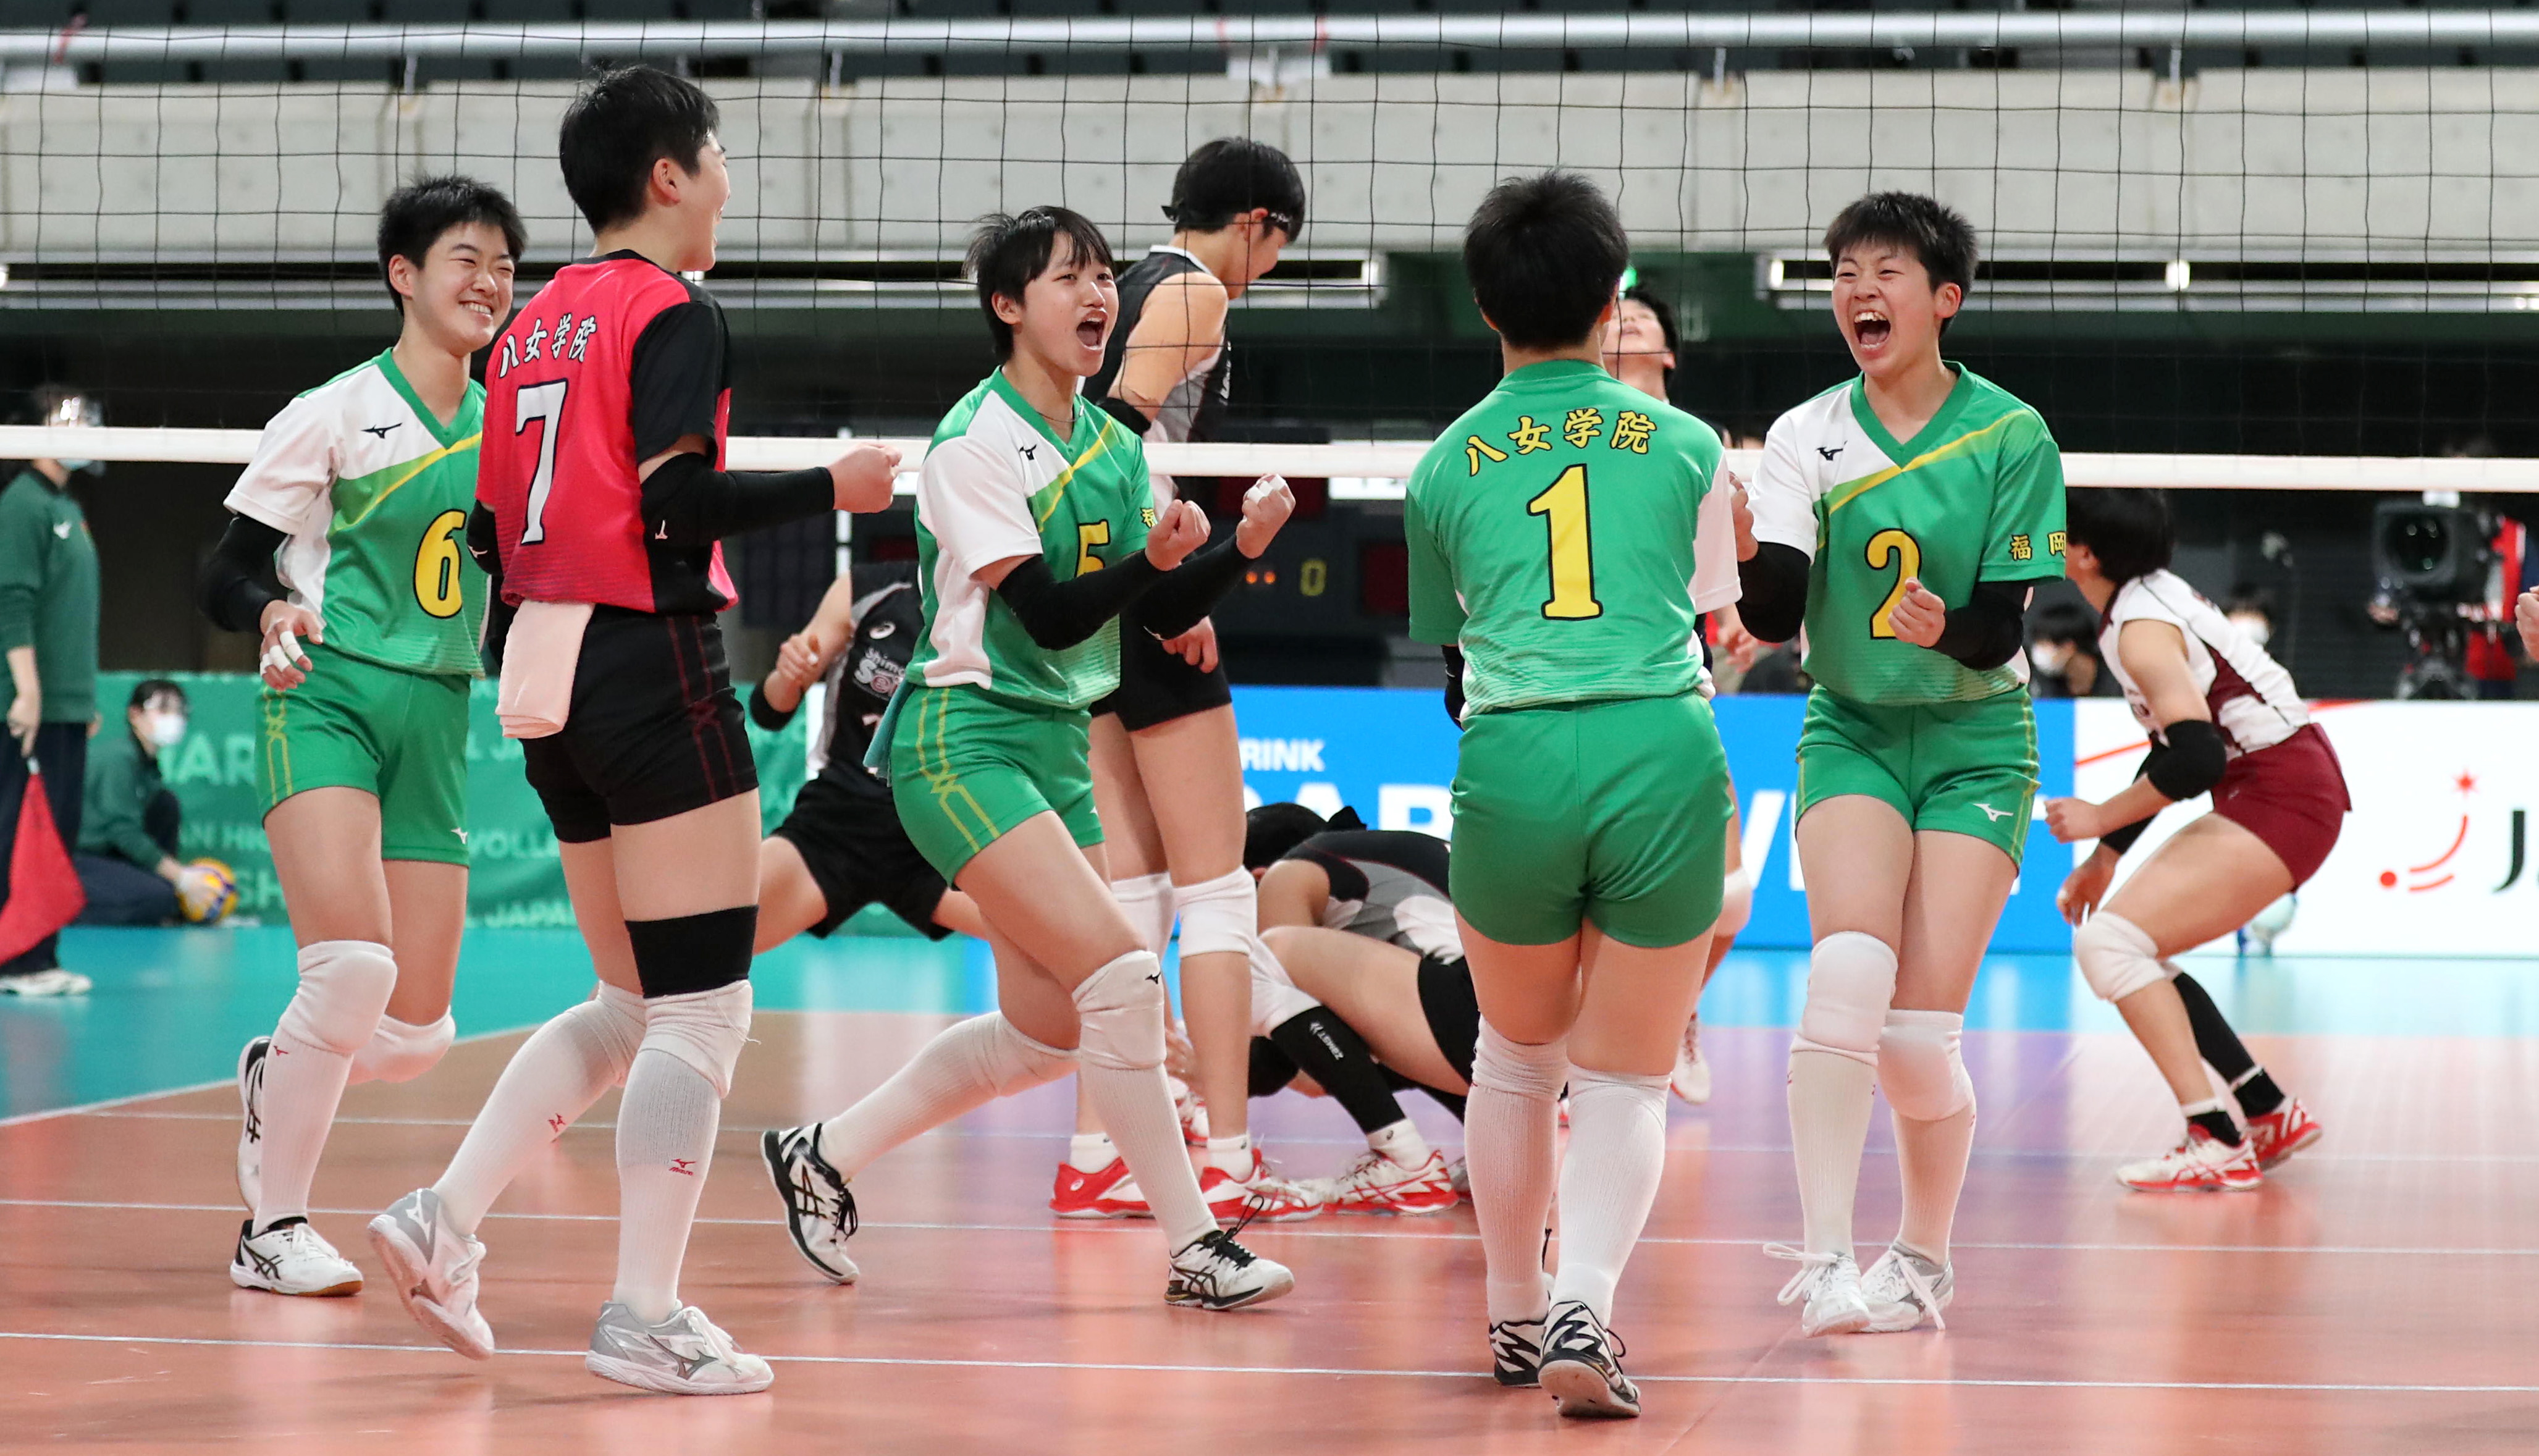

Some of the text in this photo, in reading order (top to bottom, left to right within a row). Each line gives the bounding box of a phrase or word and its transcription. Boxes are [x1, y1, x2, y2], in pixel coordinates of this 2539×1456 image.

[499, 313, 597, 379] 八女学院
[515, 377, 569, 545] 7
[1465, 408, 1657, 476] 八女学院
[413, 508, 467, 619] 6
[1526, 463, 1604, 621] 1
[1864, 528, 1922, 640] 2
[2008, 530, 2066, 561] 福岡
[2493, 810, 2539, 892] J
